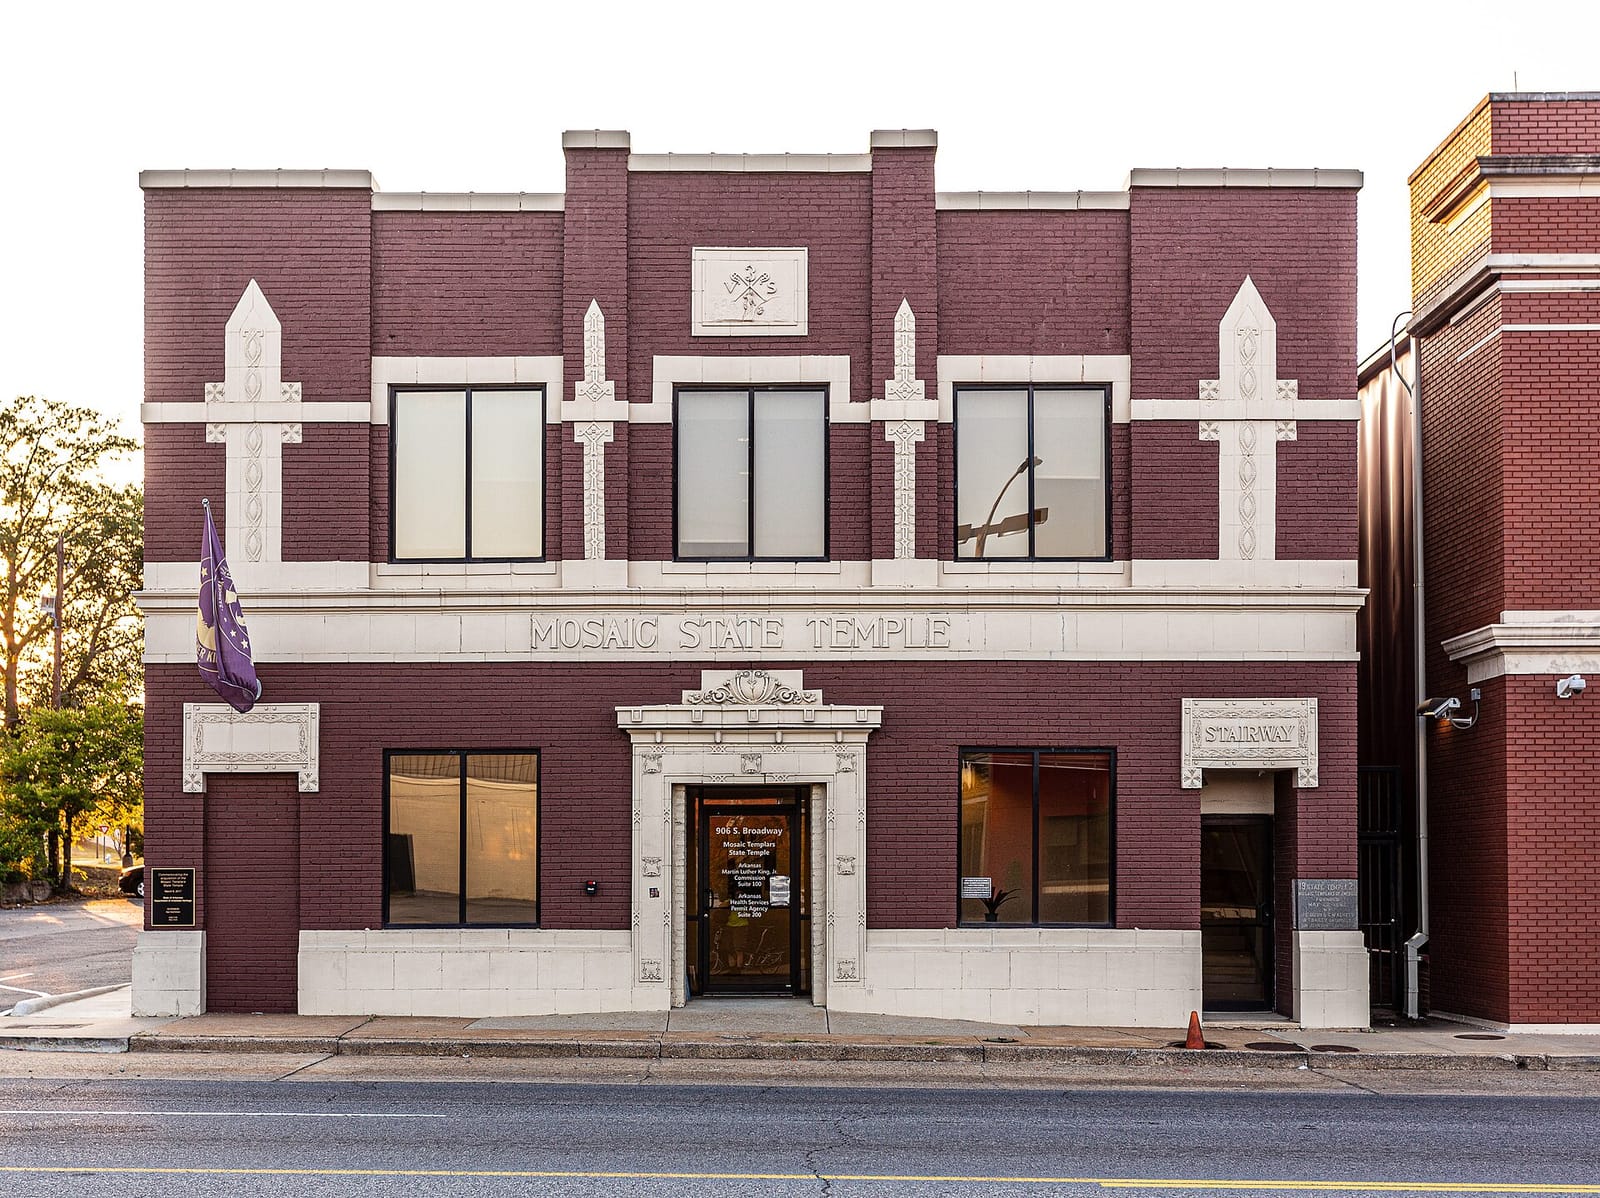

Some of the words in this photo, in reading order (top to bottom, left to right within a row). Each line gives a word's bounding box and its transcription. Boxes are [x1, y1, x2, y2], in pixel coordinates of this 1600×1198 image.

[531, 617, 658, 649] MOSAIC
[679, 617, 784, 649] STATE
[806, 617, 951, 649] TEMPLE
[1205, 725, 1296, 743] STAIRWAY
[715, 827, 731, 835] 906
[732, 827, 741, 835] S.
[742, 826, 783, 837] Broadway
[746, 841, 776, 849] Templars
[746, 849, 770, 857] Temple
